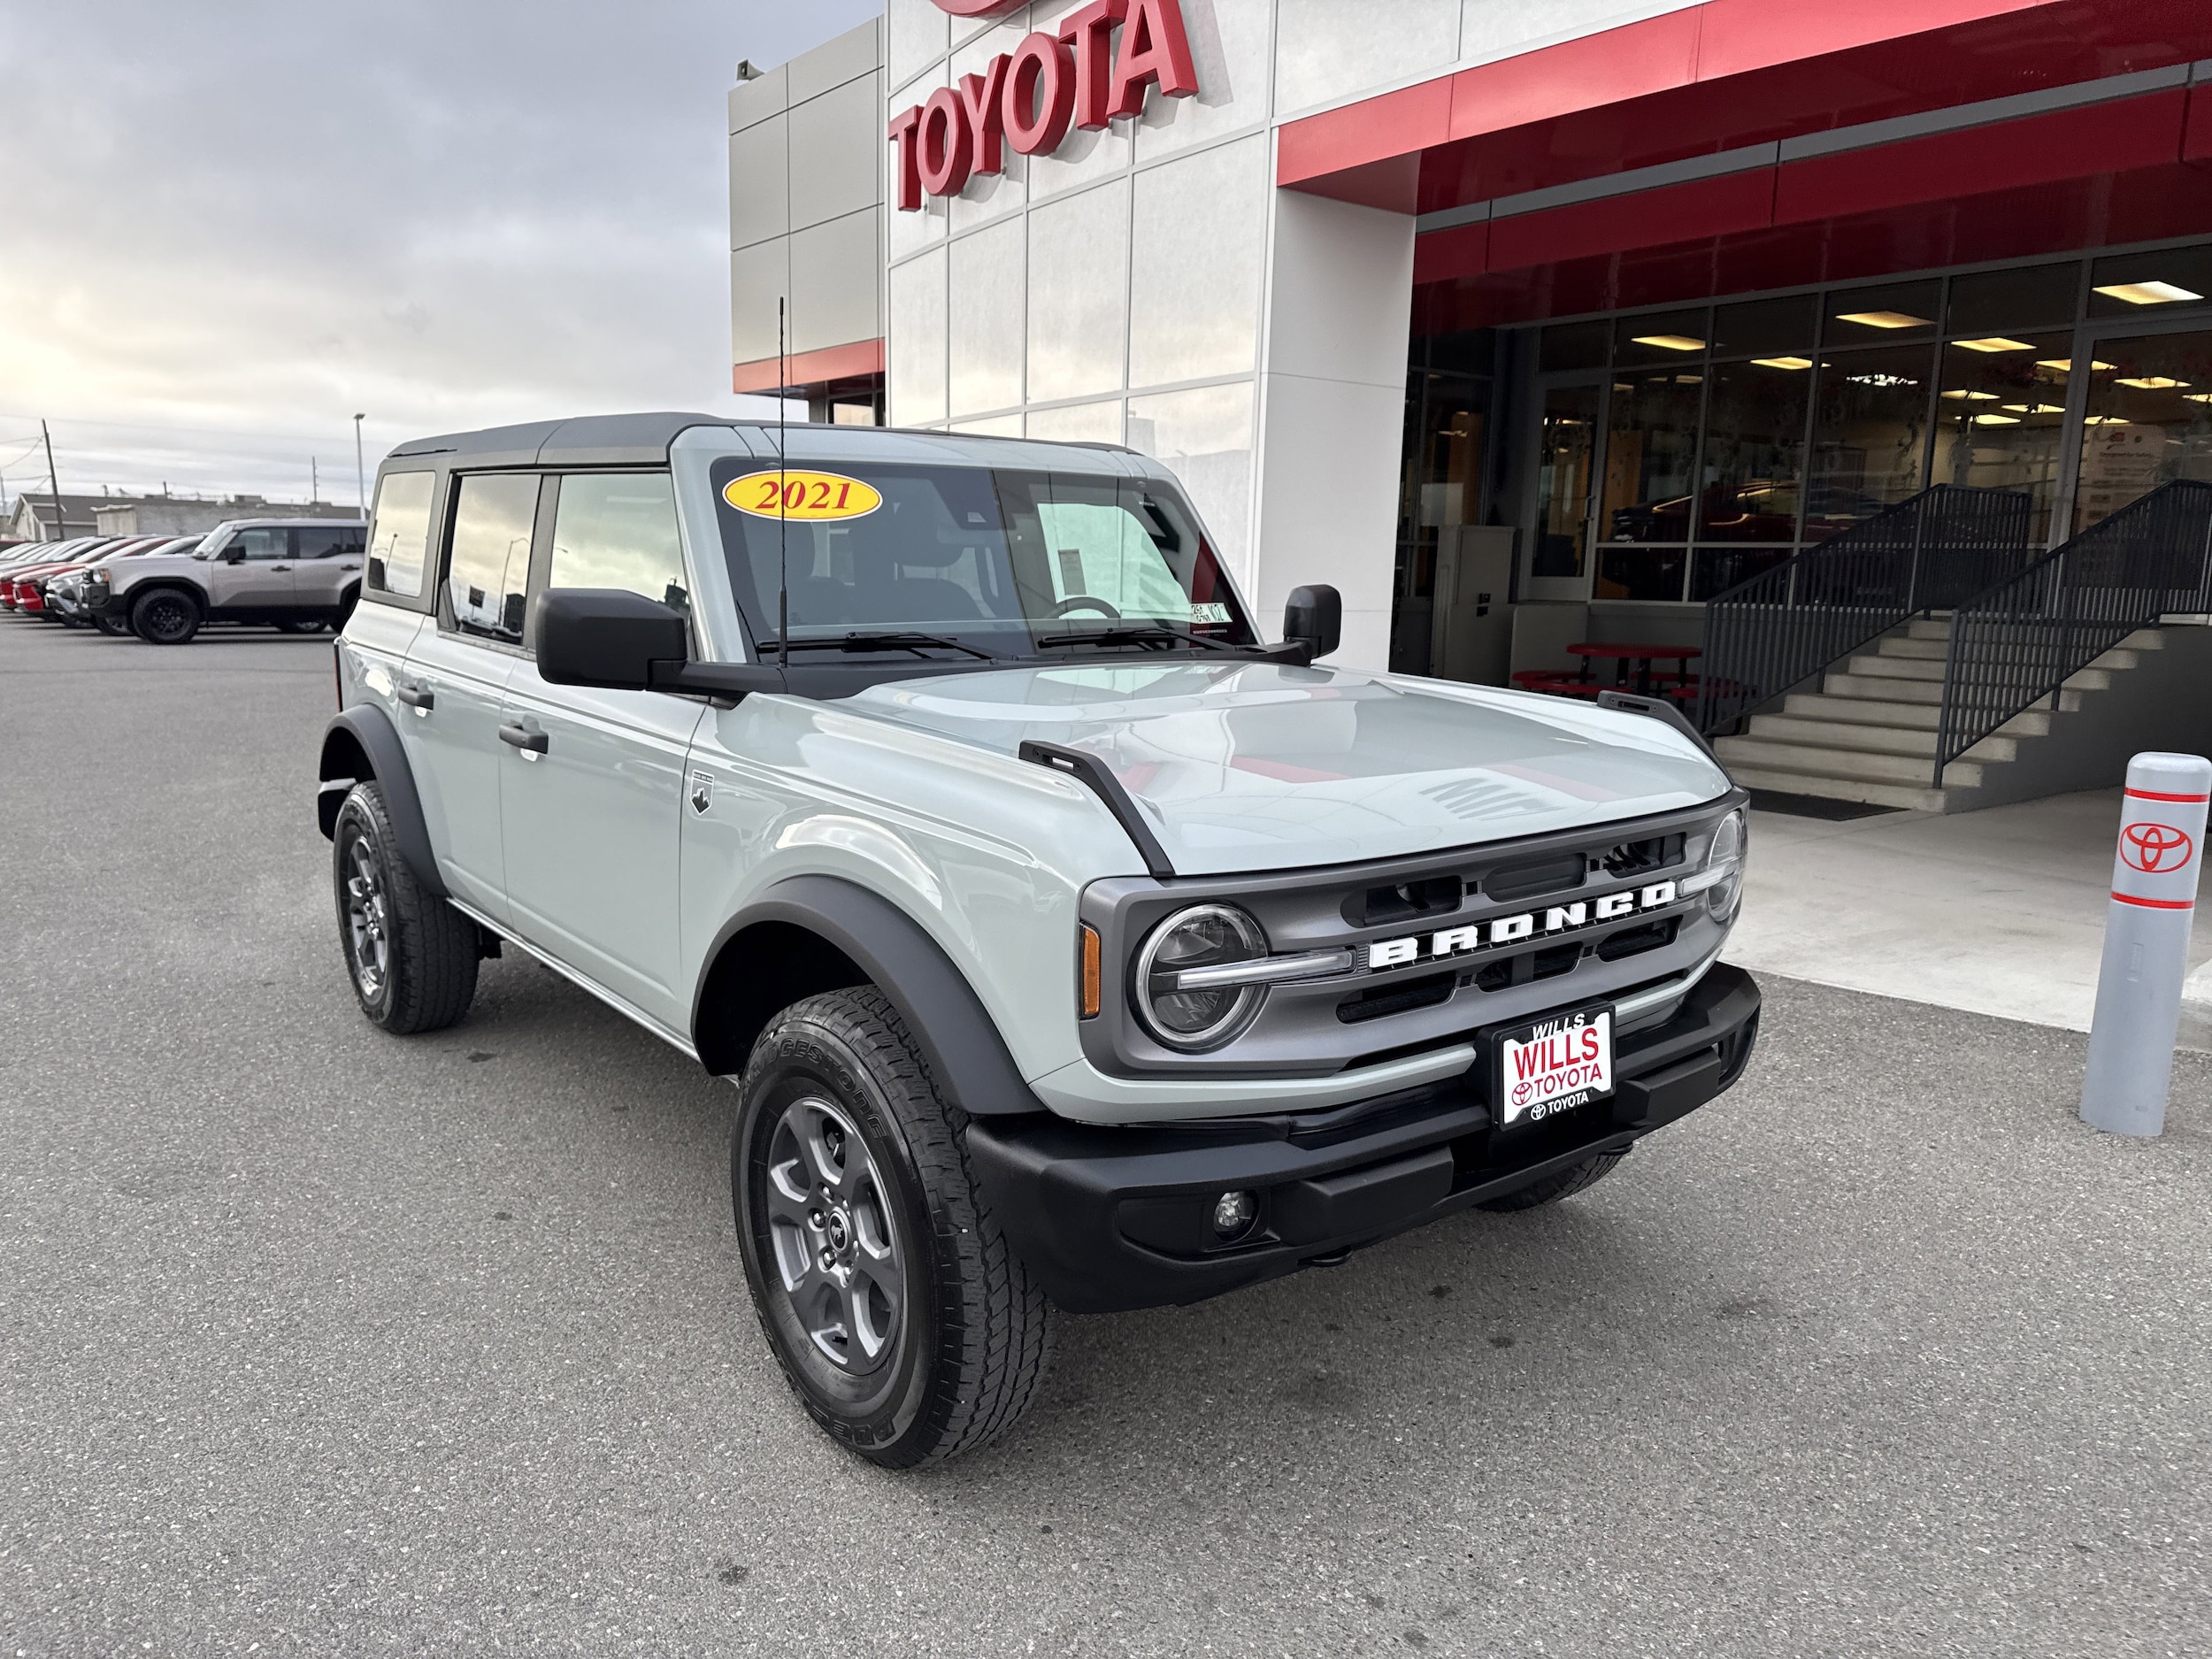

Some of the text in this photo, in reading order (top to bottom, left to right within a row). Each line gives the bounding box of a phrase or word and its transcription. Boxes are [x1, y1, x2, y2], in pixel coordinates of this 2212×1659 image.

[888, 0, 1199, 211] TOYOTA
[755, 480, 850, 509] 2021
[1369, 880, 1676, 968] BRONCO
[1532, 1013, 1586, 1041] WILLS
[1514, 1027, 1600, 1081] WILLS
[1534, 1063, 1603, 1097] TOYOTA
[1548, 1091, 1589, 1114] TOYOTA
